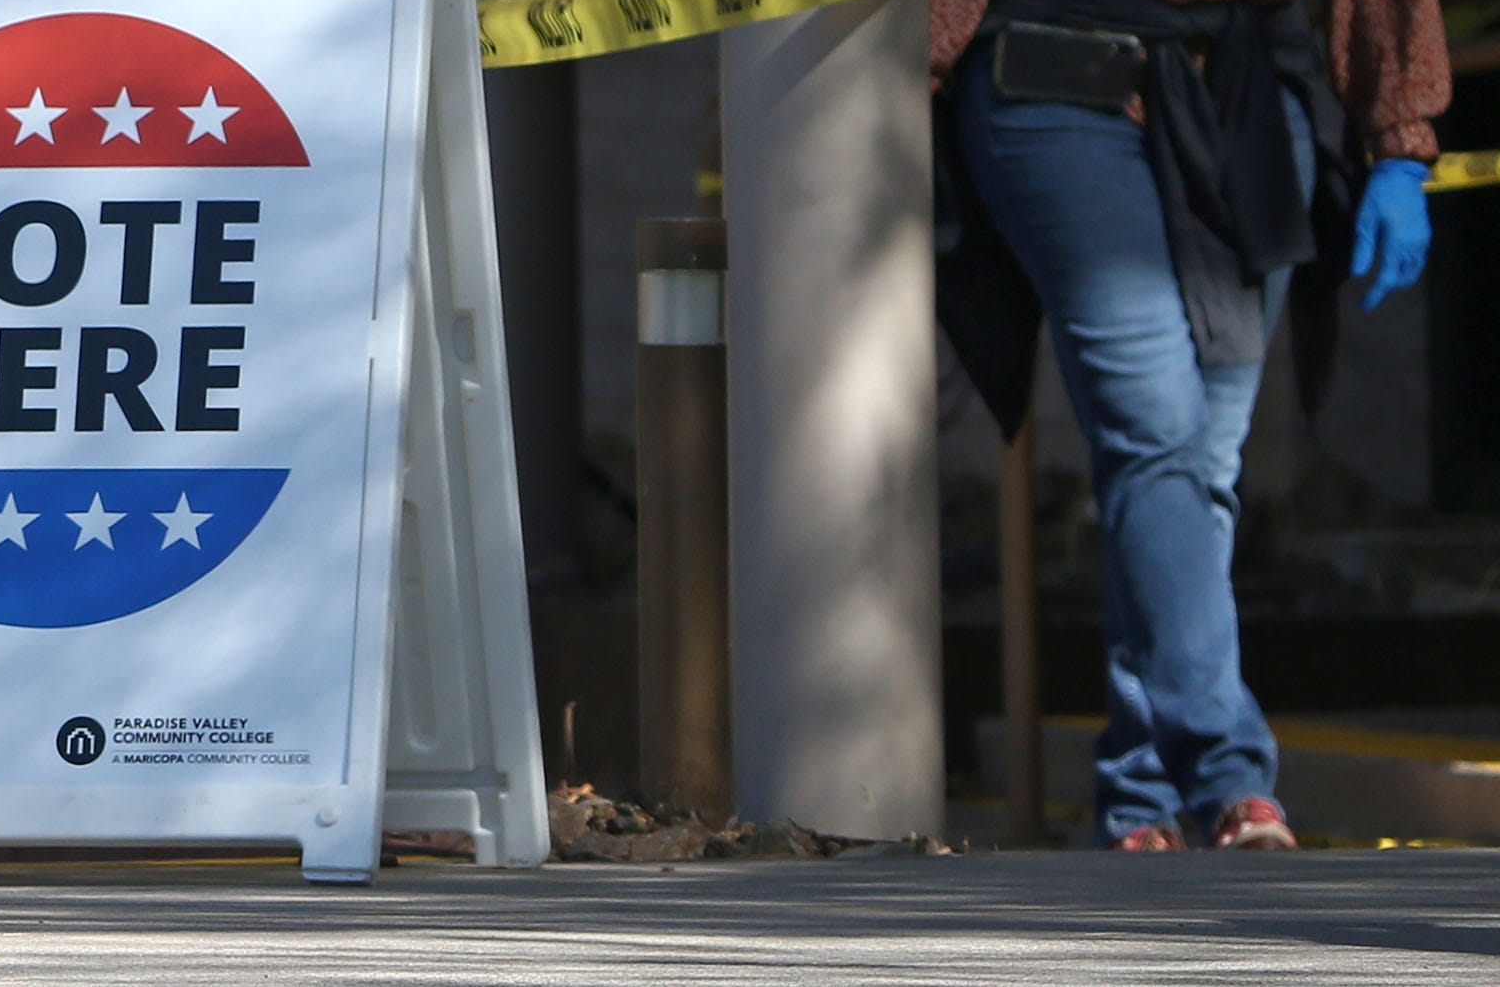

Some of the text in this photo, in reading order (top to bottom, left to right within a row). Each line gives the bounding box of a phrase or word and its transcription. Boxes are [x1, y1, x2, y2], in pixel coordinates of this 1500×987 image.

[114, 718, 249, 729] PARADISE VALLEY
[113, 731, 275, 744] COMMUNITY COLLEGE
[112, 754, 312, 764] A MARICOPA COMMUNITY COLLEGE
